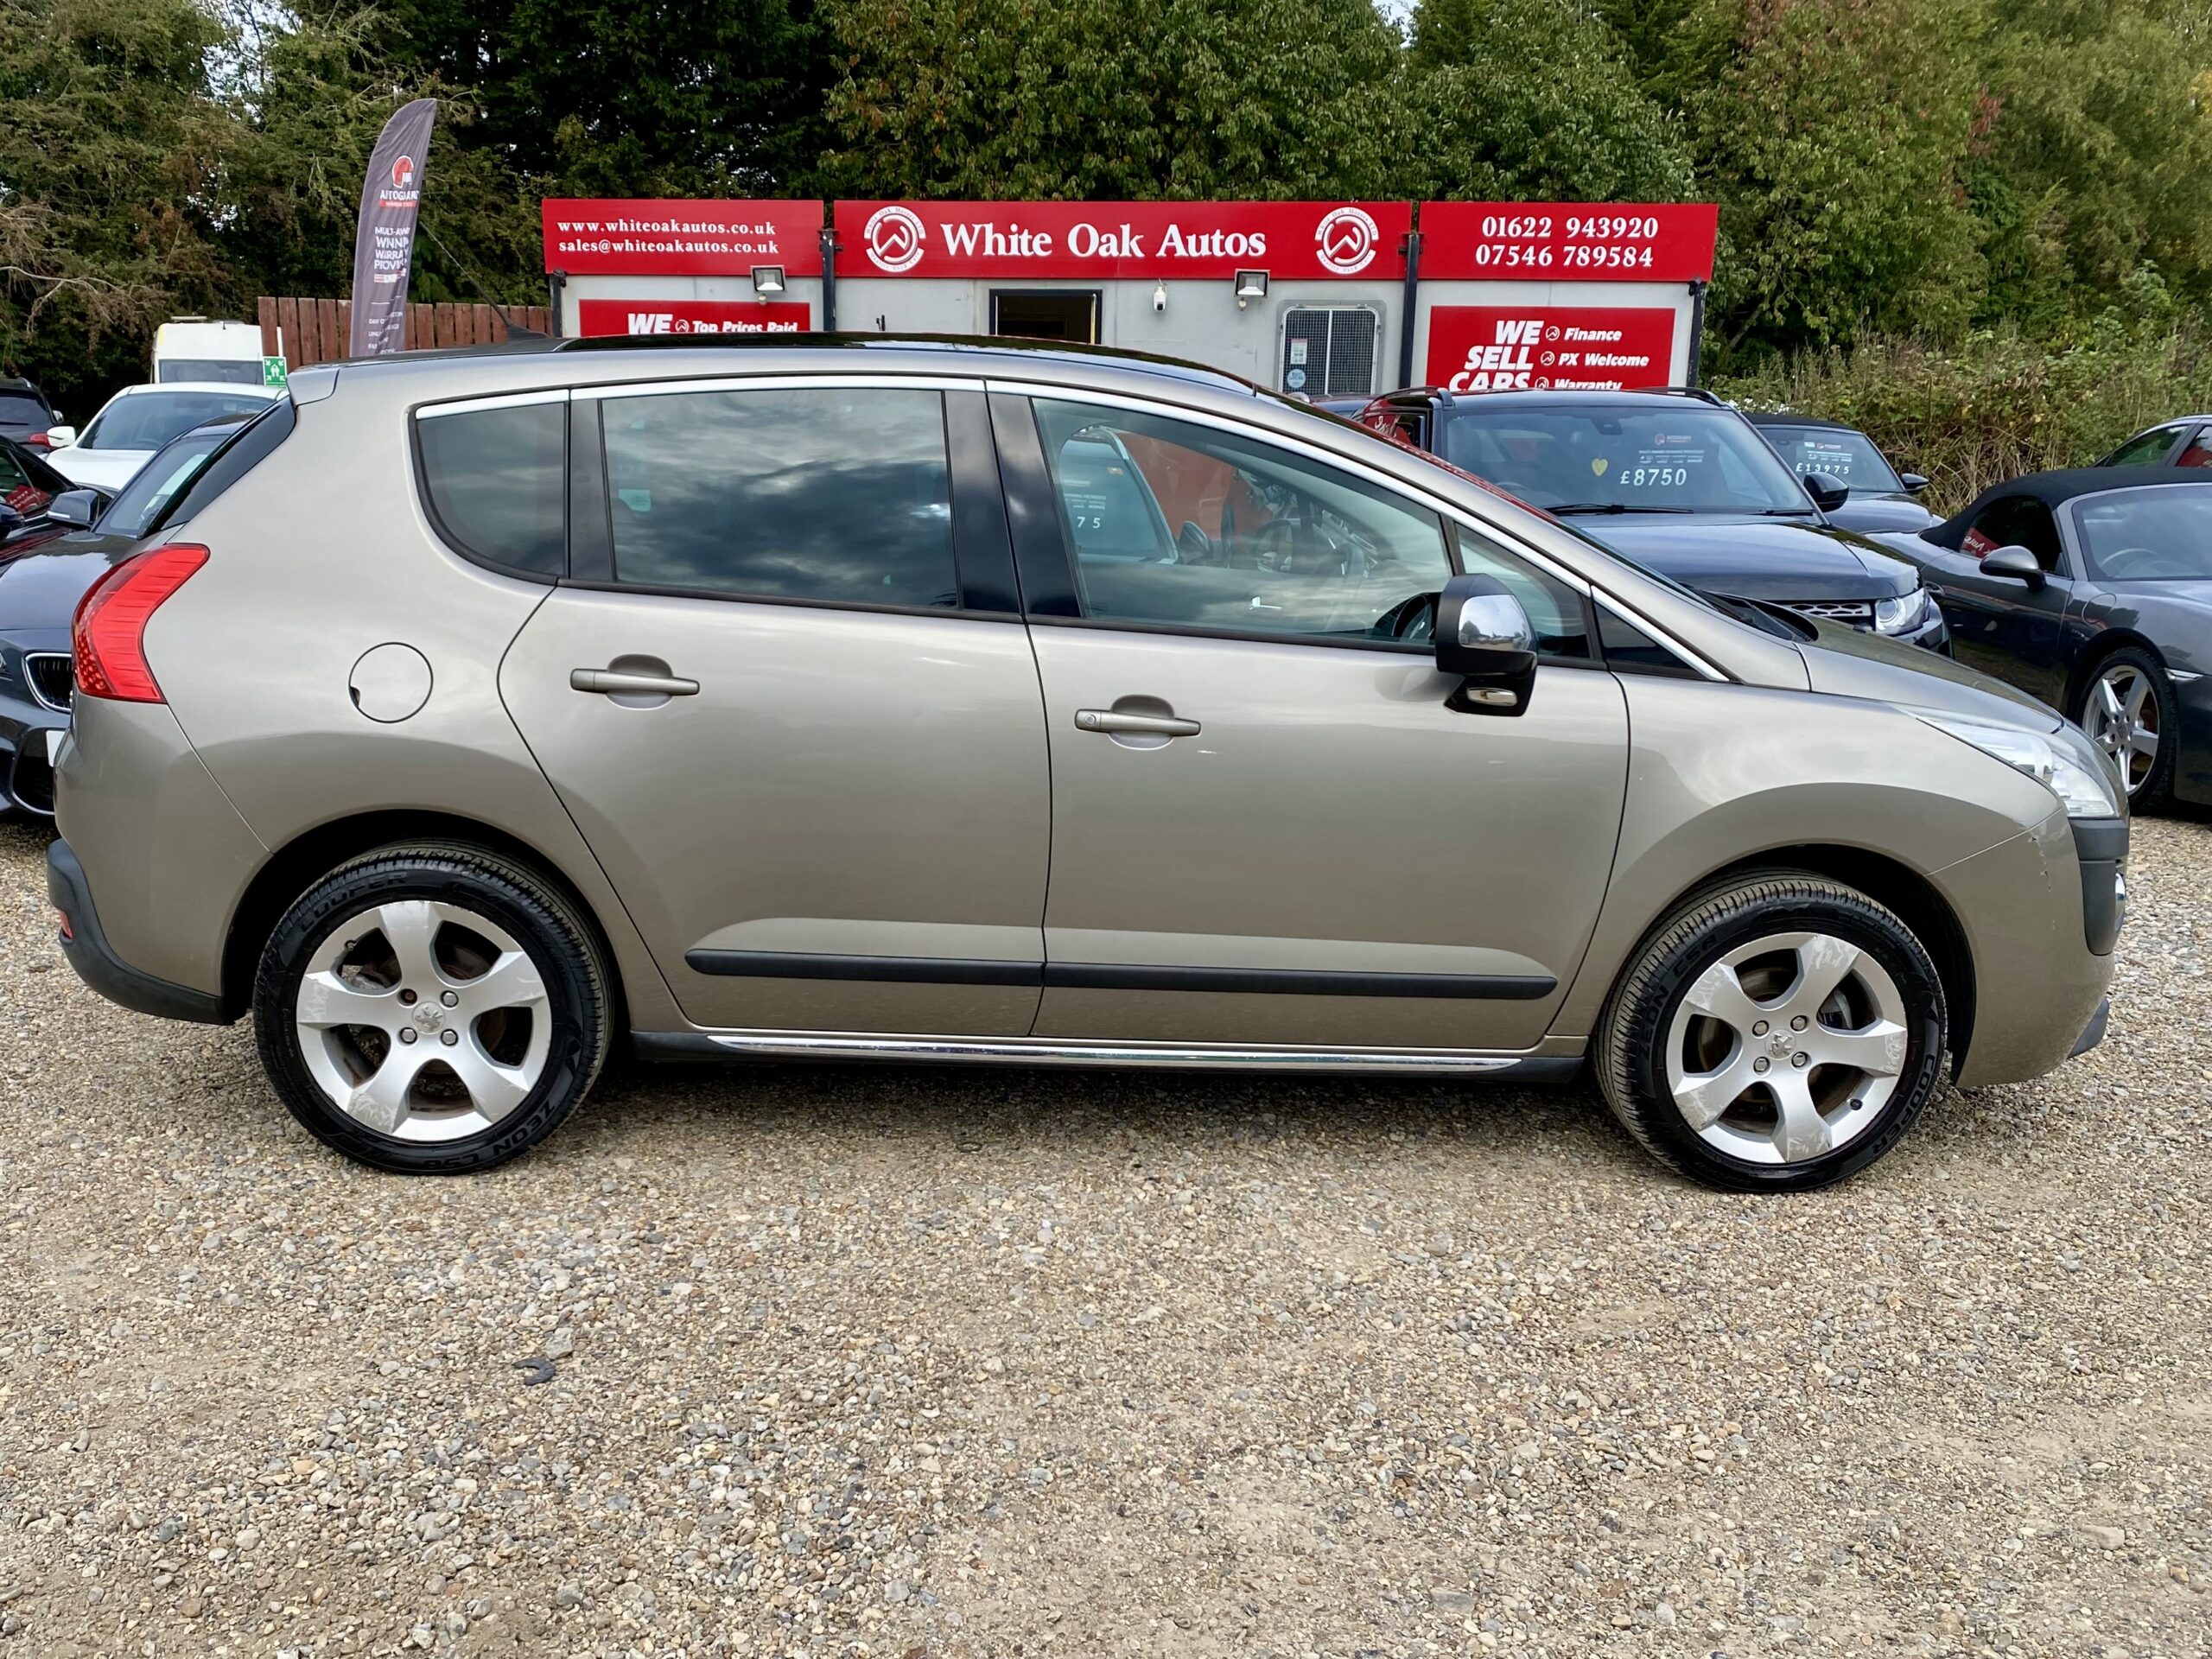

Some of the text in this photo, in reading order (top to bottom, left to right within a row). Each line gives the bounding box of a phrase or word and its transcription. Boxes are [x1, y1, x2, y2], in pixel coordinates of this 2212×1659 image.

[556, 218, 776, 235] www.whiteoakautos.co.uk
[1481, 216, 1659, 239] 01622 943920
[558, 238, 779, 254] sales@whiteoakautos.co.uk
[940, 222, 1266, 257] White Oak Autos
[1475, 244, 1654, 268] 07546 789584
[627, 313, 673, 334] WE
[691, 320, 798, 332] Top Prices Paid
[1495, 320, 1544, 345] WE
[1564, 327, 1623, 342] Finance
[1465, 346, 1534, 370] SELL
[1558, 353, 1649, 366] PX Welcome
[1448, 372, 1531, 391] CARS
[1554, 378, 1623, 389] Warranty
[1620, 468, 1688, 486] £8750
[1796, 462, 1850, 474] £13975
[1872, 1054, 1936, 1154] COOPER
[493, 1098, 556, 1157] ZEON
